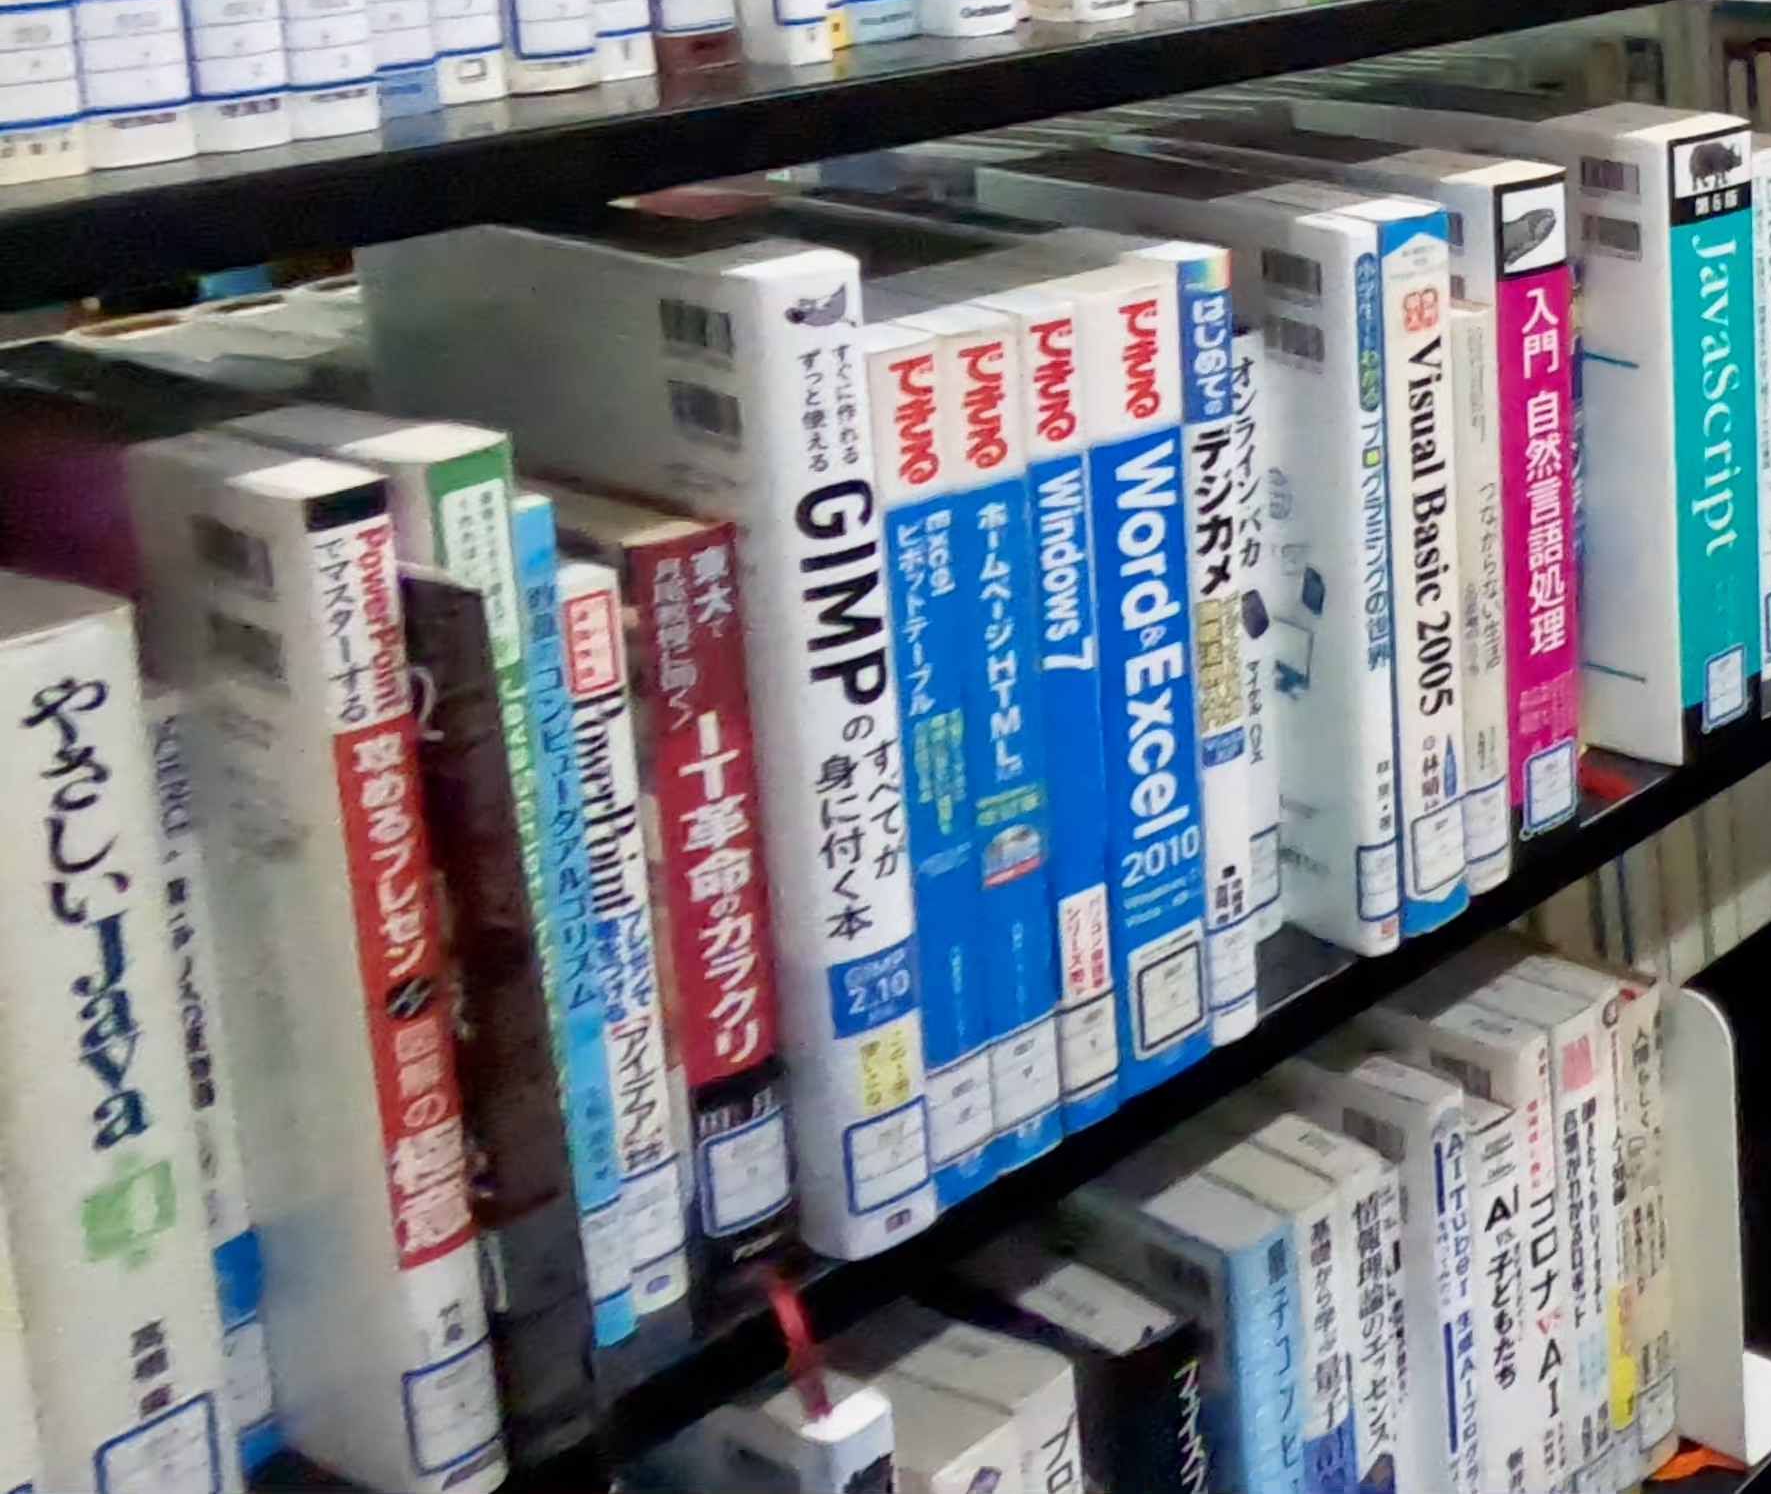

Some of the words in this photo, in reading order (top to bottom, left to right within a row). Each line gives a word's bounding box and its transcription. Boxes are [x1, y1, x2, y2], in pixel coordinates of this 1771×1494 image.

[1029, 316, 1078, 442] できる
[1117, 297, 1162, 421] できる
[1521, 287, 1560, 379] 入門
[1691, 232, 1742, 557] JavaScript
[888, 353, 941, 486] できる
[956, 339, 1009, 469] できる
[1408, 334, 1446, 481] Visual
[1036, 467, 1086, 643] Windows
[1192, 425, 1234, 596] デジカメ
[1411, 480, 1451, 605] Basic
[1523, 390, 1567, 656] 自然言語処理
[1416, 610, 1455, 717] 2005
[815, 754, 873, 941] 身に付く本
[1121, 825, 1201, 890] 2010
[1529, 1197, 1559, 1311] コロナ
